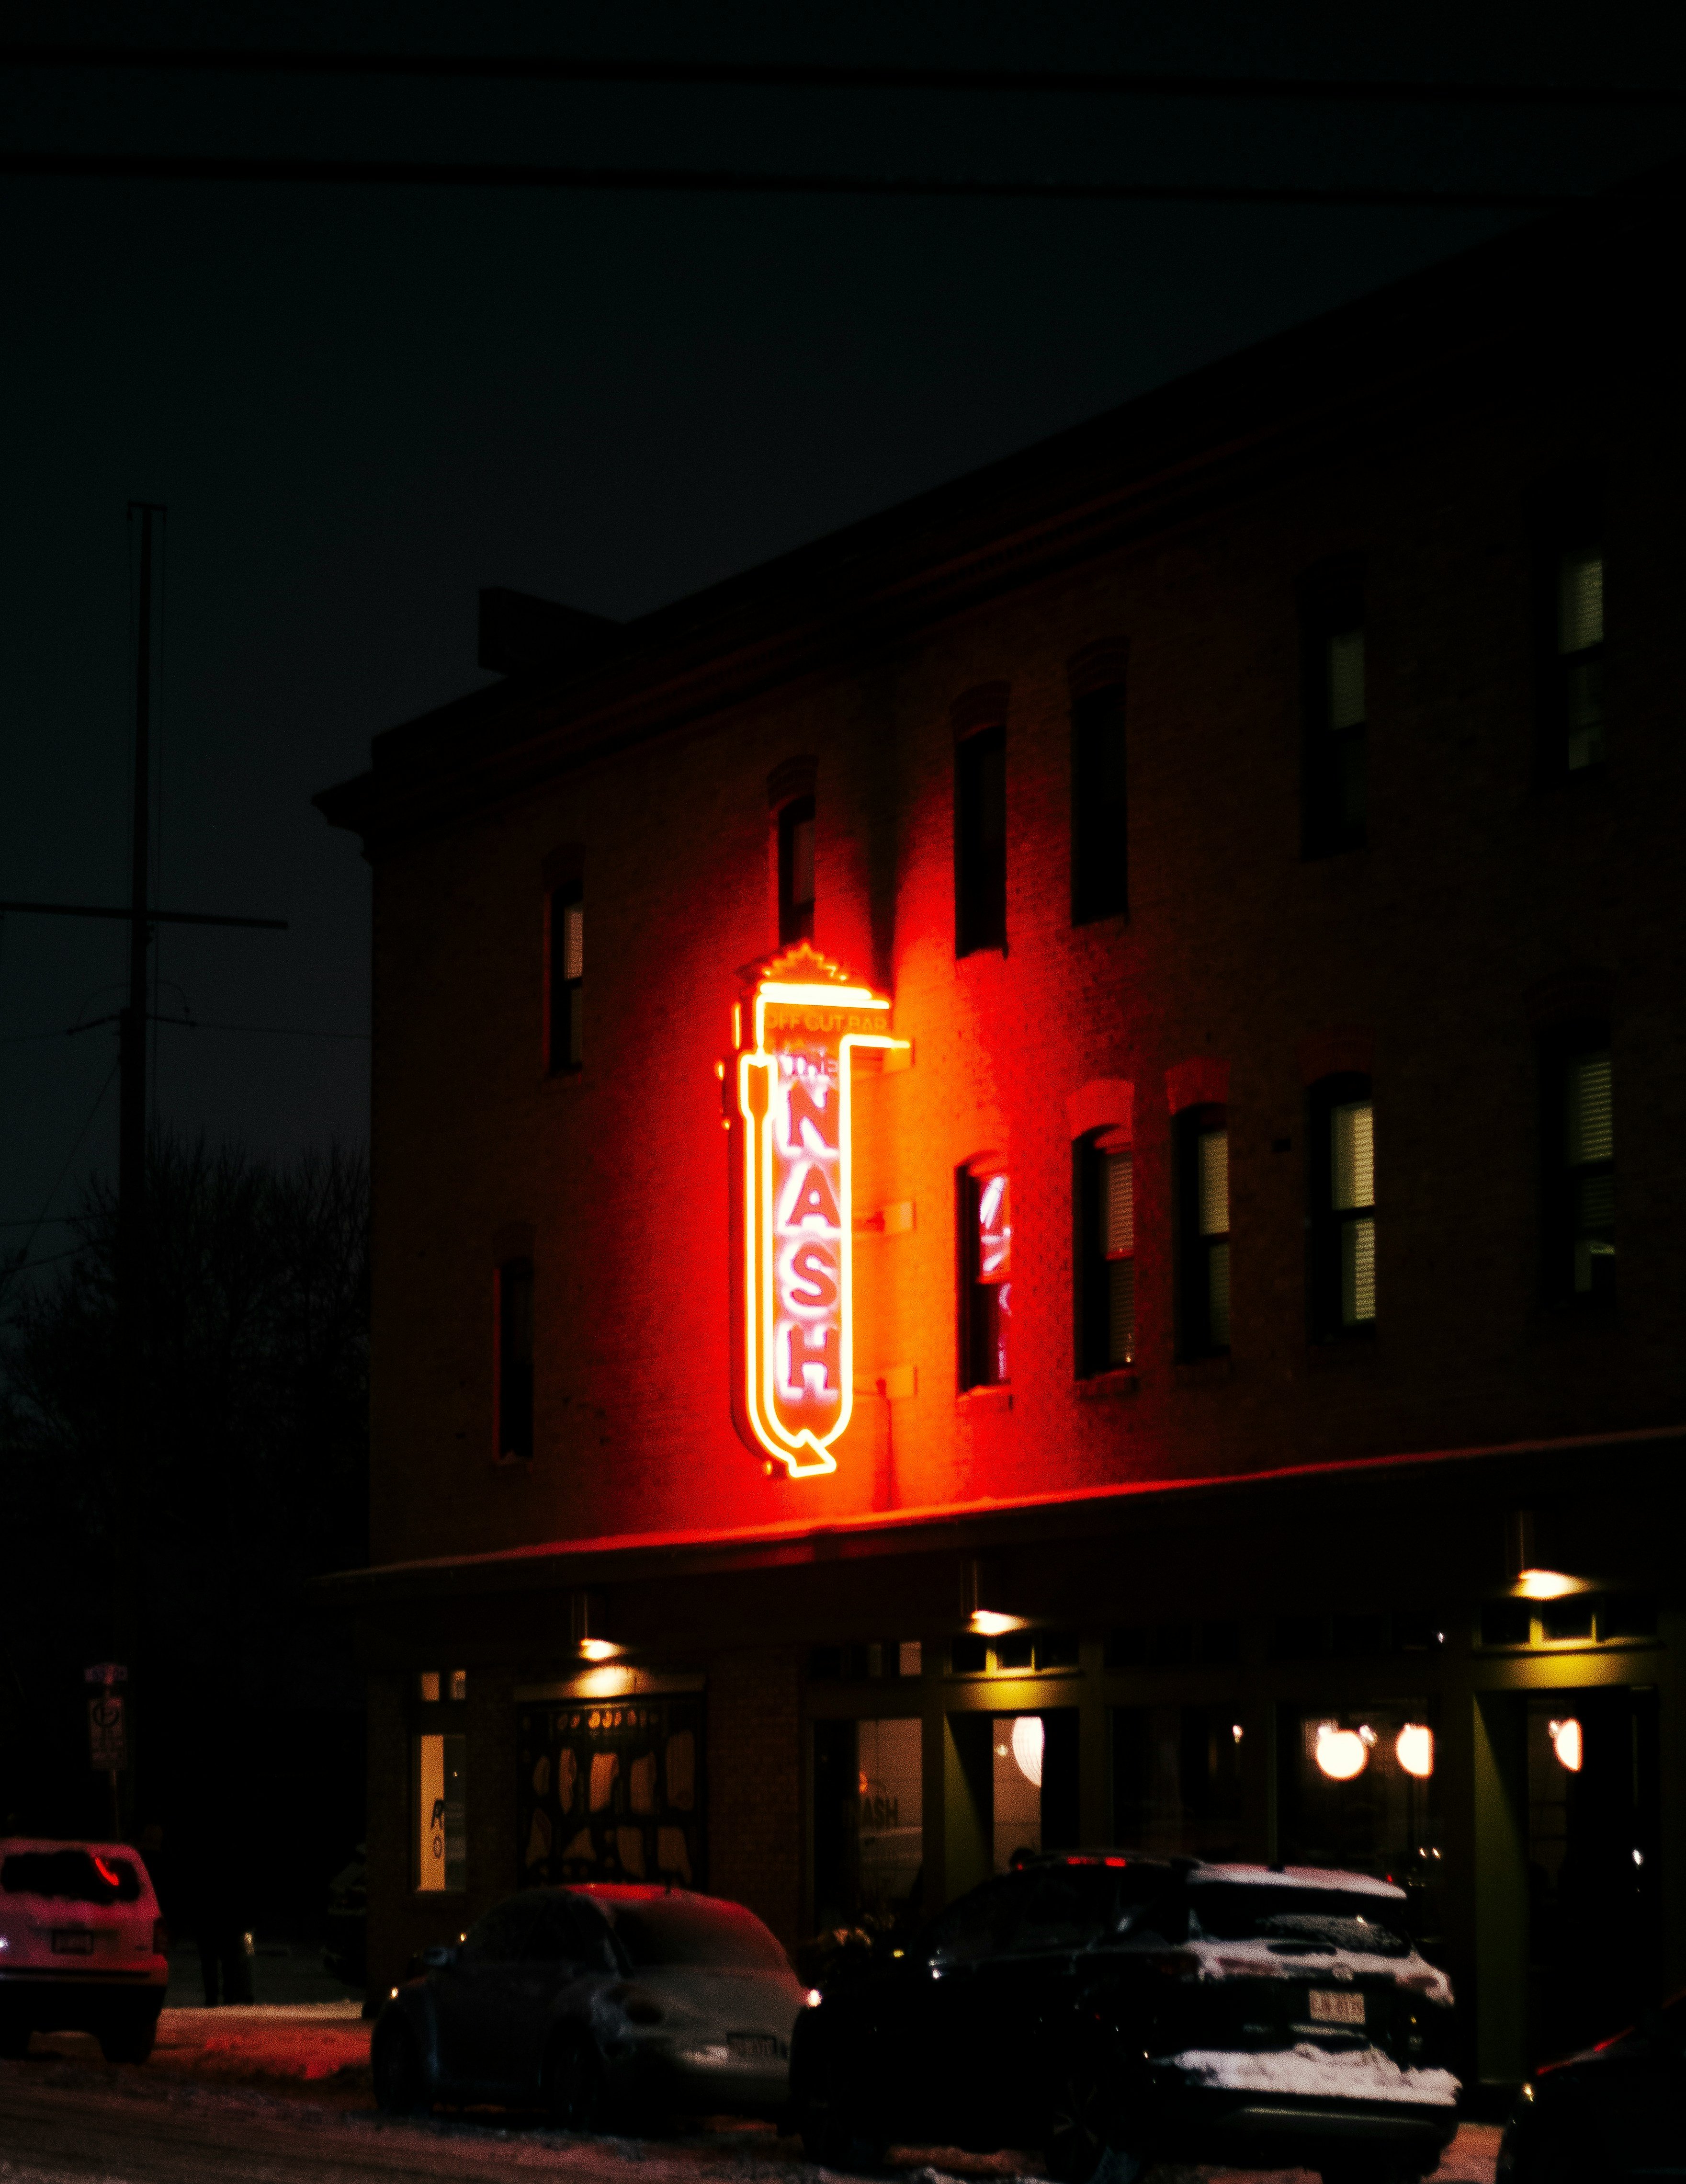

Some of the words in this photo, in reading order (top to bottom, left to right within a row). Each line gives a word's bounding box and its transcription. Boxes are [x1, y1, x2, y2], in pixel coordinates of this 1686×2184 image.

[804, 1013, 844, 1032] CUT
[848, 1015, 887, 1031] BAR
[785, 1079, 841, 1391] NASH
